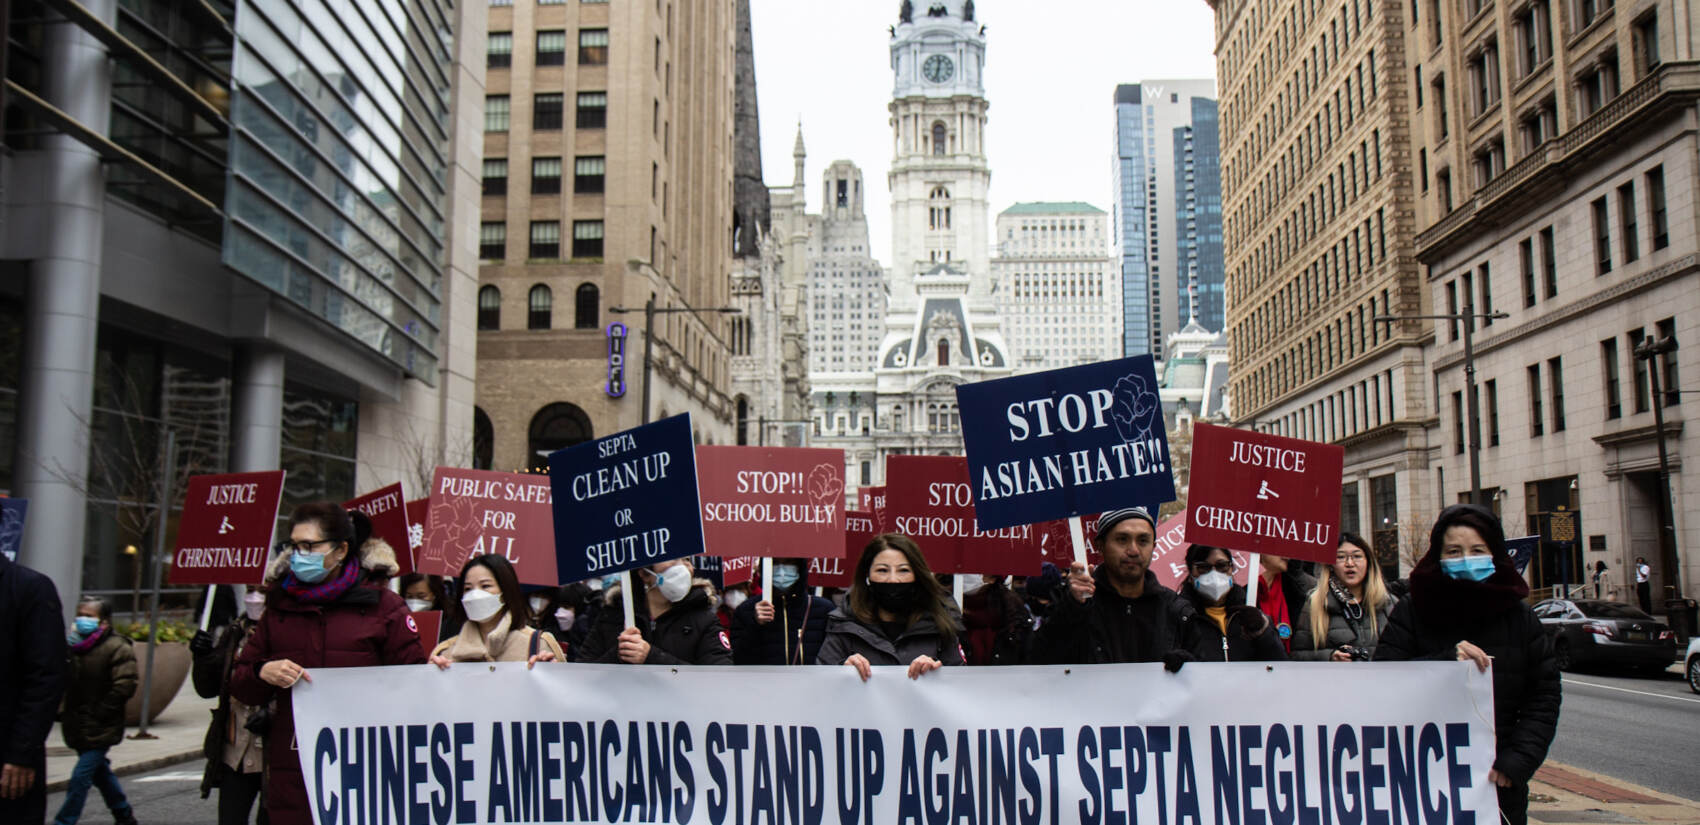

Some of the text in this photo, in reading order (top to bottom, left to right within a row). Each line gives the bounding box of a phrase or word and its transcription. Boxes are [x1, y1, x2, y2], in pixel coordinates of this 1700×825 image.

[1144, 85, 1164, 98] W
[611, 326, 622, 393] aloft
[1007, 388, 1114, 442] STOP
[598, 433, 637, 459] SEPTA
[1229, 441, 1306, 473] JUSTICE
[572, 451, 671, 501] CLEAN UP
[980, 437, 1165, 500] ASIAN HATE!!
[206, 483, 258, 505] JUSTICE
[440, 476, 502, 499] PUBLIC
[736, 471, 803, 494] STOP!!
[928, 482, 975, 507] STO
[482, 510, 516, 531] FOR
[614, 508, 634, 527] OR
[705, 502, 836, 524] SCHOOL BULLY
[1195, 505, 1331, 546] CHRISTINA LU
[895, 516, 969, 537] SCHOOL
[177, 547, 265, 568] CHRISTINA LU
[468, 535, 520, 564] ALL
[585, 527, 670, 572] SHUT UP
[808, 557, 844, 575] ALL
[315, 719, 1476, 825] CHINESE AMERICANS STAND UP AGAINST SEPTA NEGLIGENCE
